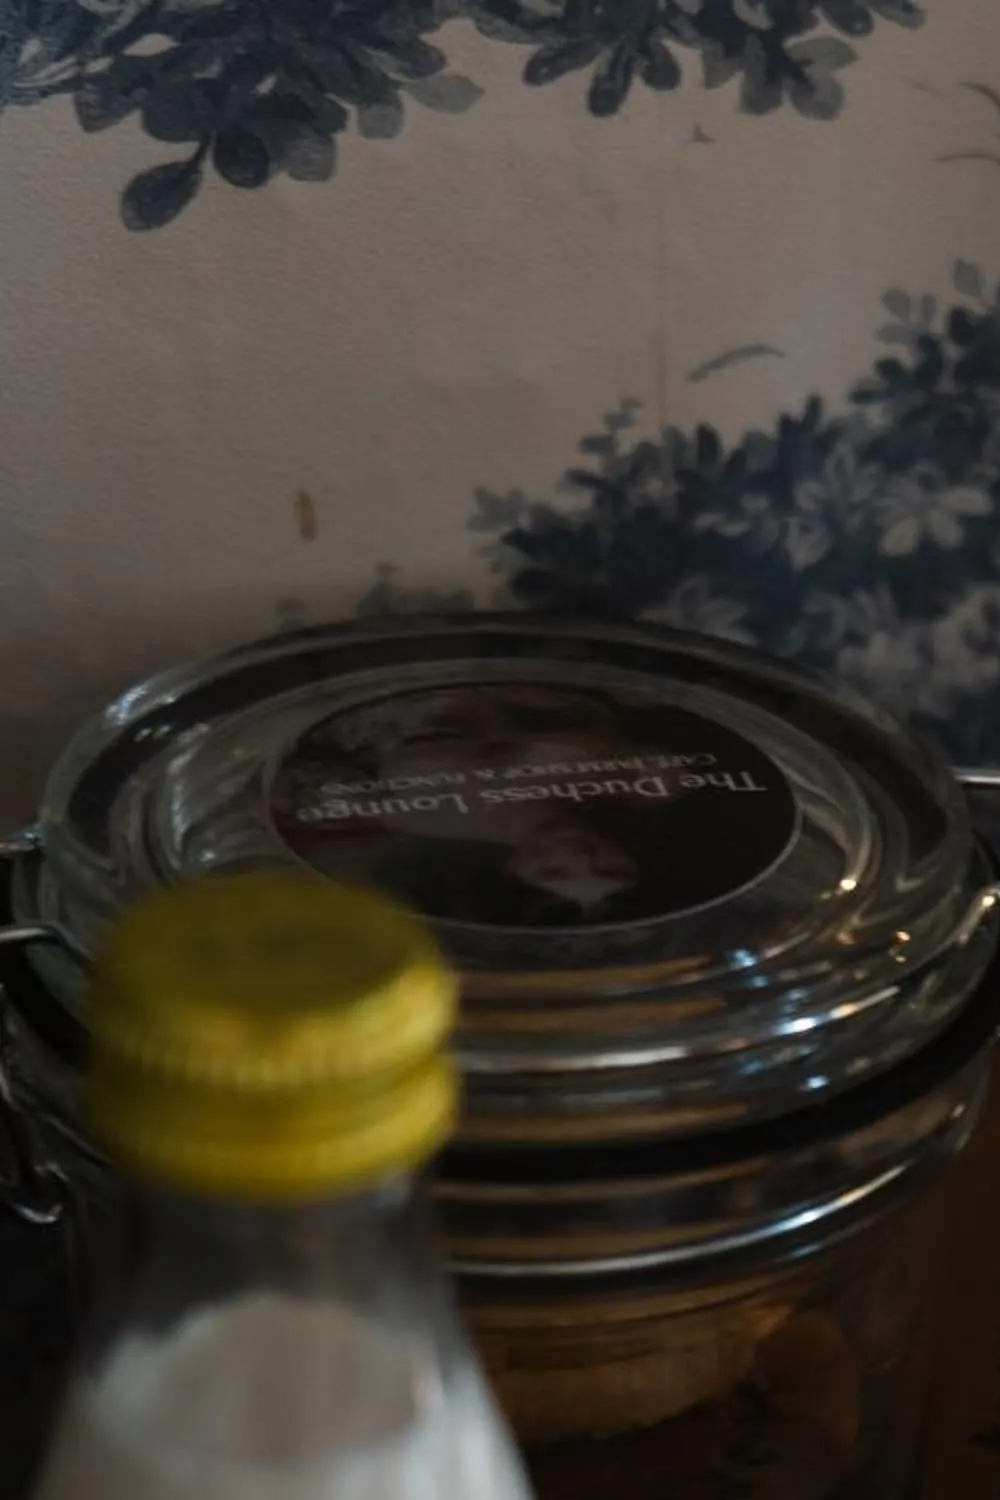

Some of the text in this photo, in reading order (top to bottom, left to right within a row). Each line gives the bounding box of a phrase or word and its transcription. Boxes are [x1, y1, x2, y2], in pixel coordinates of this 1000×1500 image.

[472, 769, 496, 782] &
[295, 769, 769, 823] The Duchess Lounge
